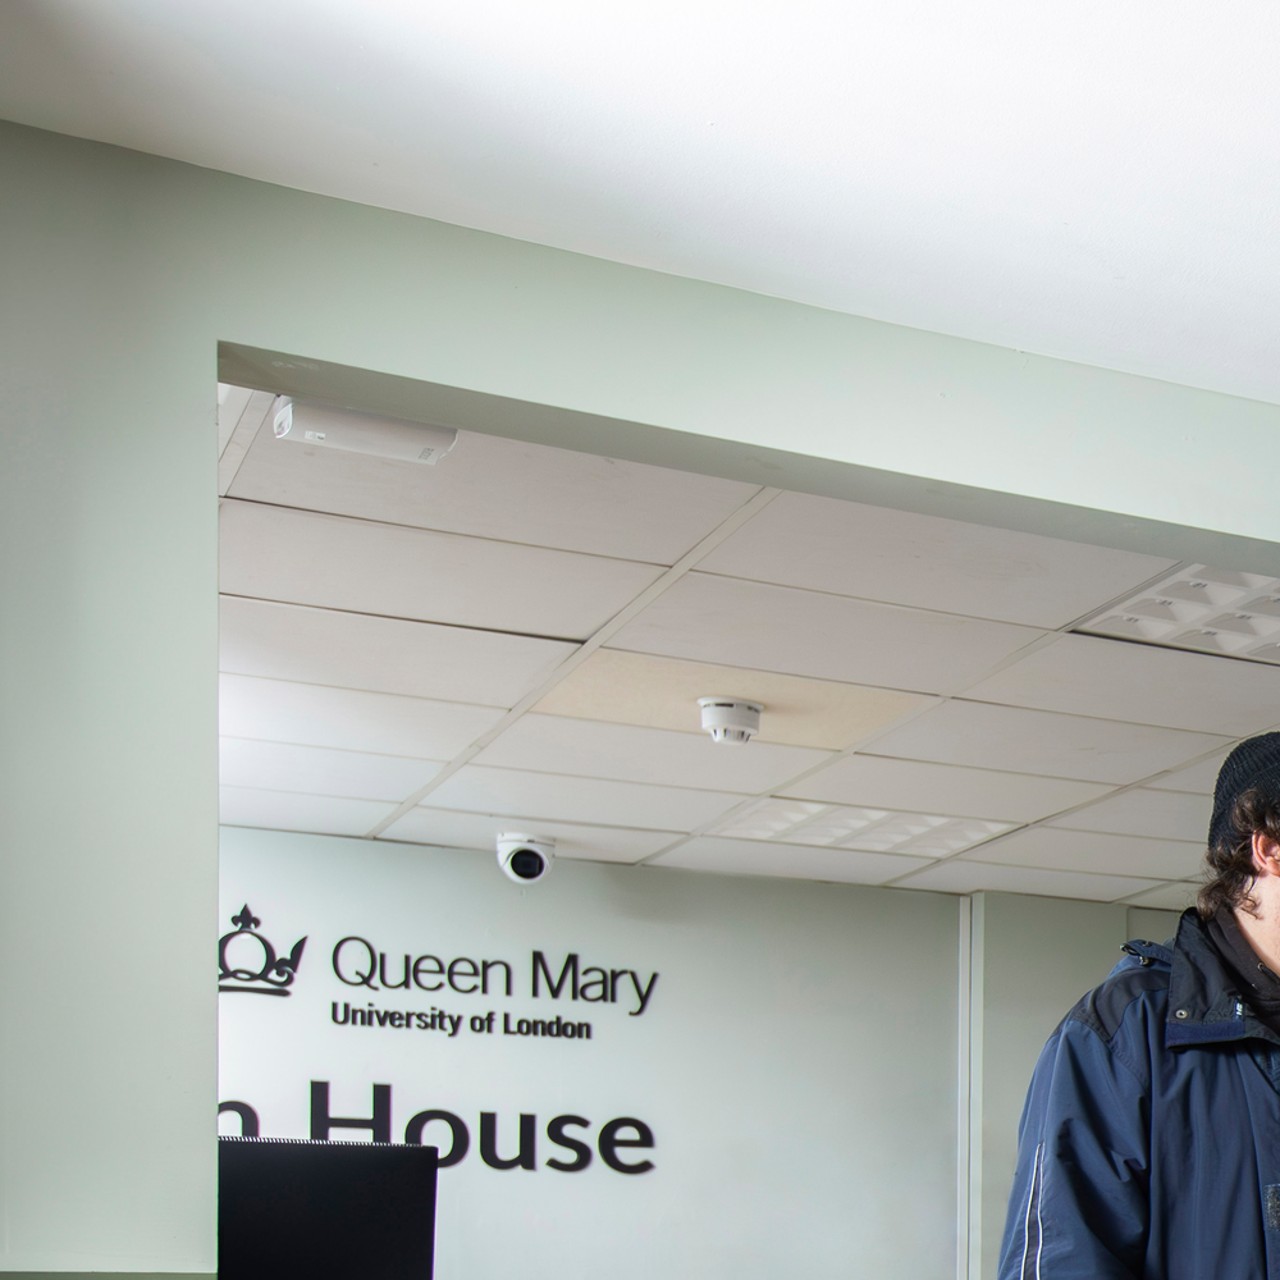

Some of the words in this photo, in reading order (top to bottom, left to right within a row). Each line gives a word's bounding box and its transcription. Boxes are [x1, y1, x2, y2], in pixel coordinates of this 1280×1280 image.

[332, 936, 513, 997] Queen
[531, 950, 659, 1017] Mary
[331, 1001, 463, 1037] University
[469, 1011, 496, 1034] of
[503, 1012, 592, 1040] London
[310, 1079, 656, 1175] House
